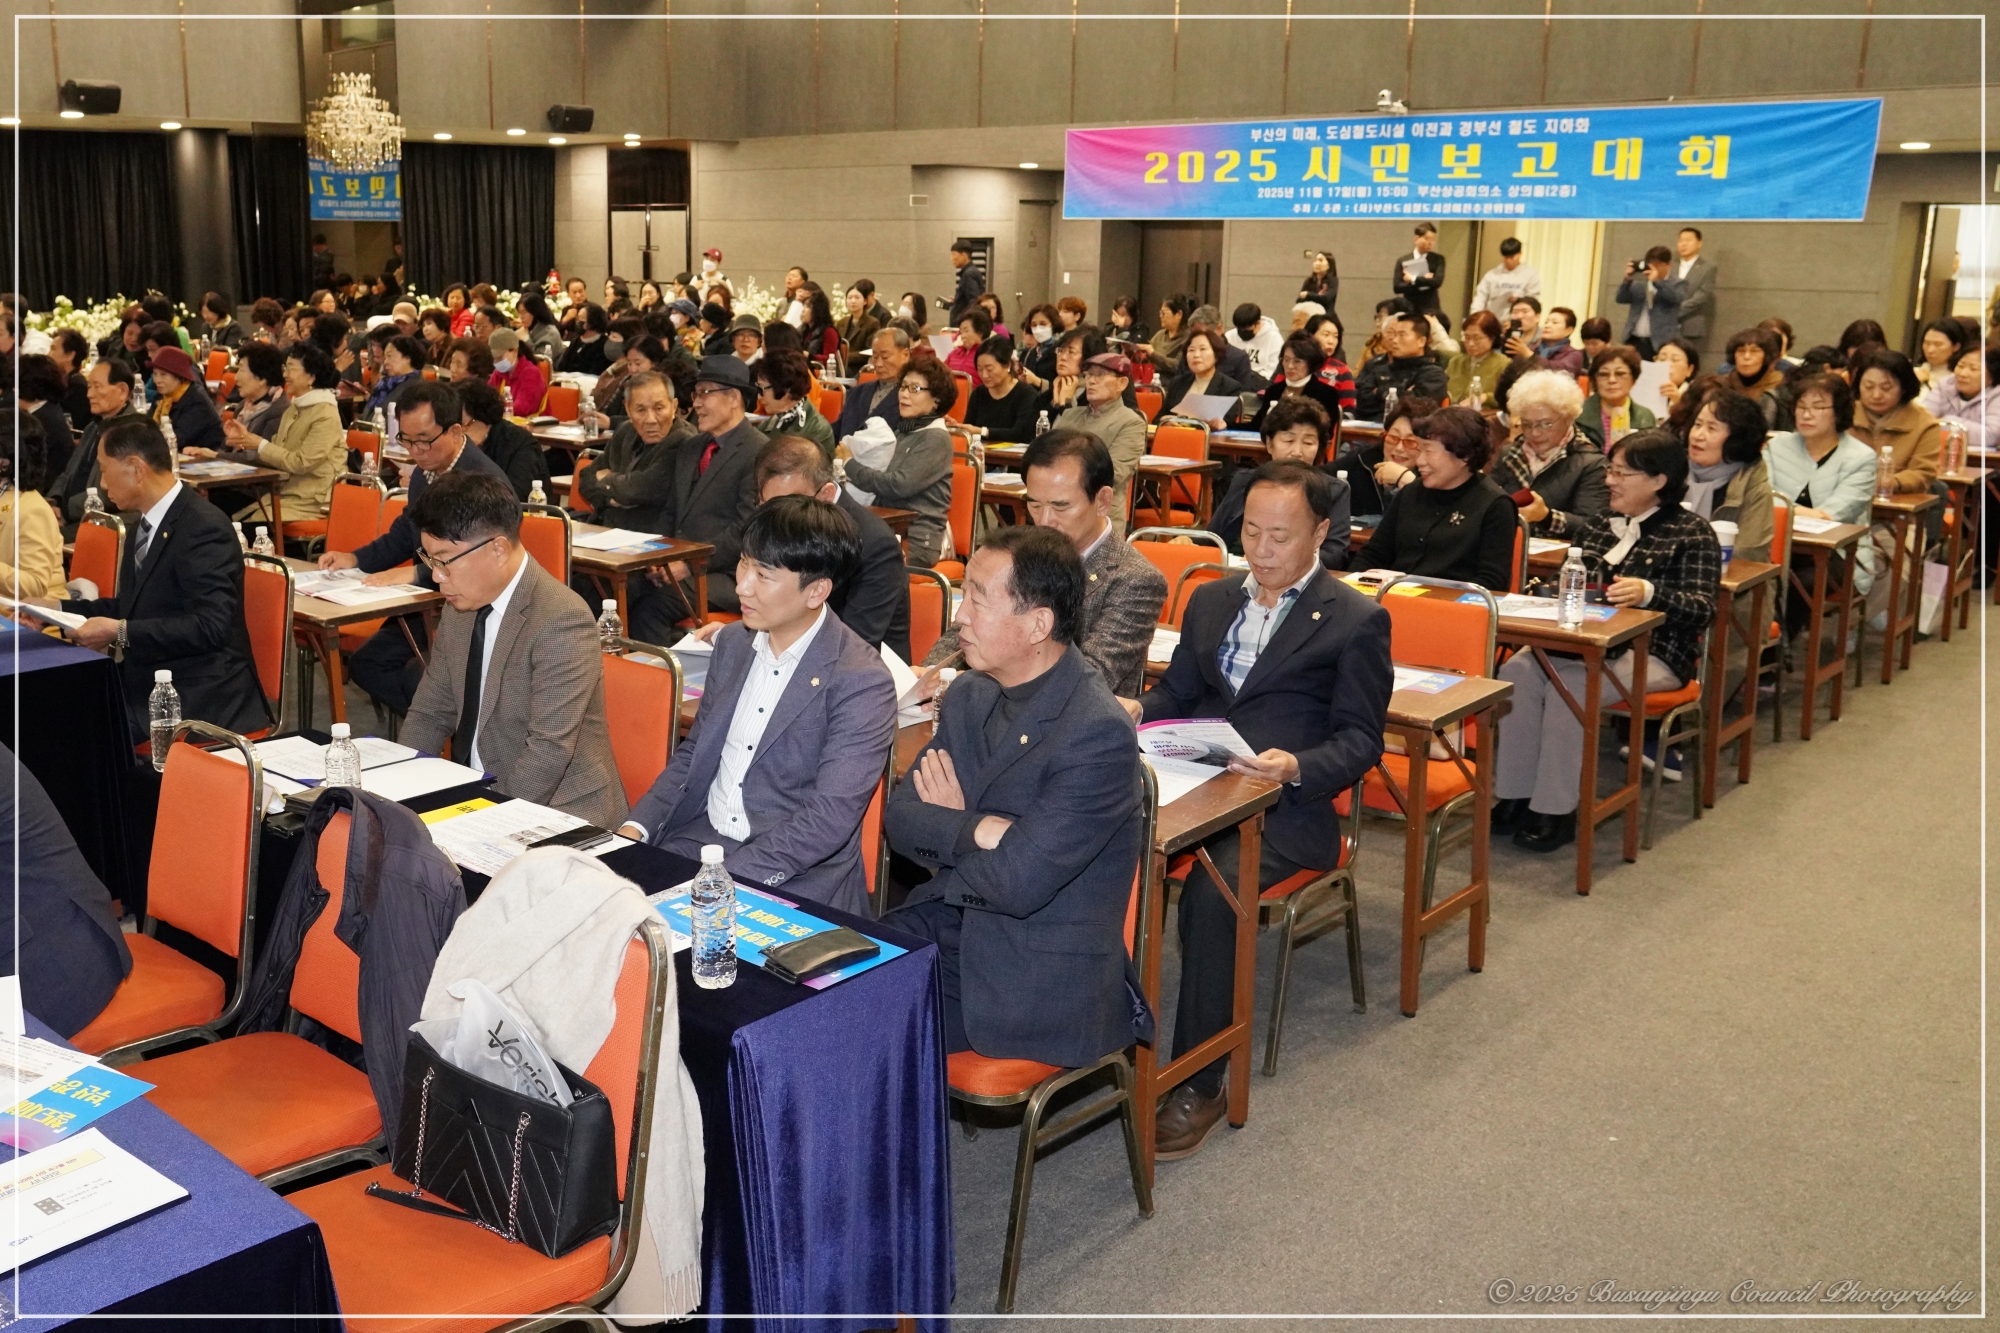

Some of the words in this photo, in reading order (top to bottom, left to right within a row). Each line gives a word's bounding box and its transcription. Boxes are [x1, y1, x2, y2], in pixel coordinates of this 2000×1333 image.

[1251, 128, 1286, 143] 부산의
[1293, 126, 1320, 141] 미래,
[1326, 123, 1405, 140] 도심철도시설
[1411, 121, 1453, 137] 이전과
[1459, 120, 1502, 136] 경부선
[1508, 119, 1537, 135] 철도
[1544, 117, 1590, 134] 지하화
[1144, 147, 1278, 184] 2025
[1257, 187, 1294, 199] 2025년
[1299, 186, 1323, 199] 11월
[1328, 186, 1372, 199] 17일(월)
[1377, 185, 1408, 198] 15:00
[1417, 185, 1503, 198] 부산상공회의소
